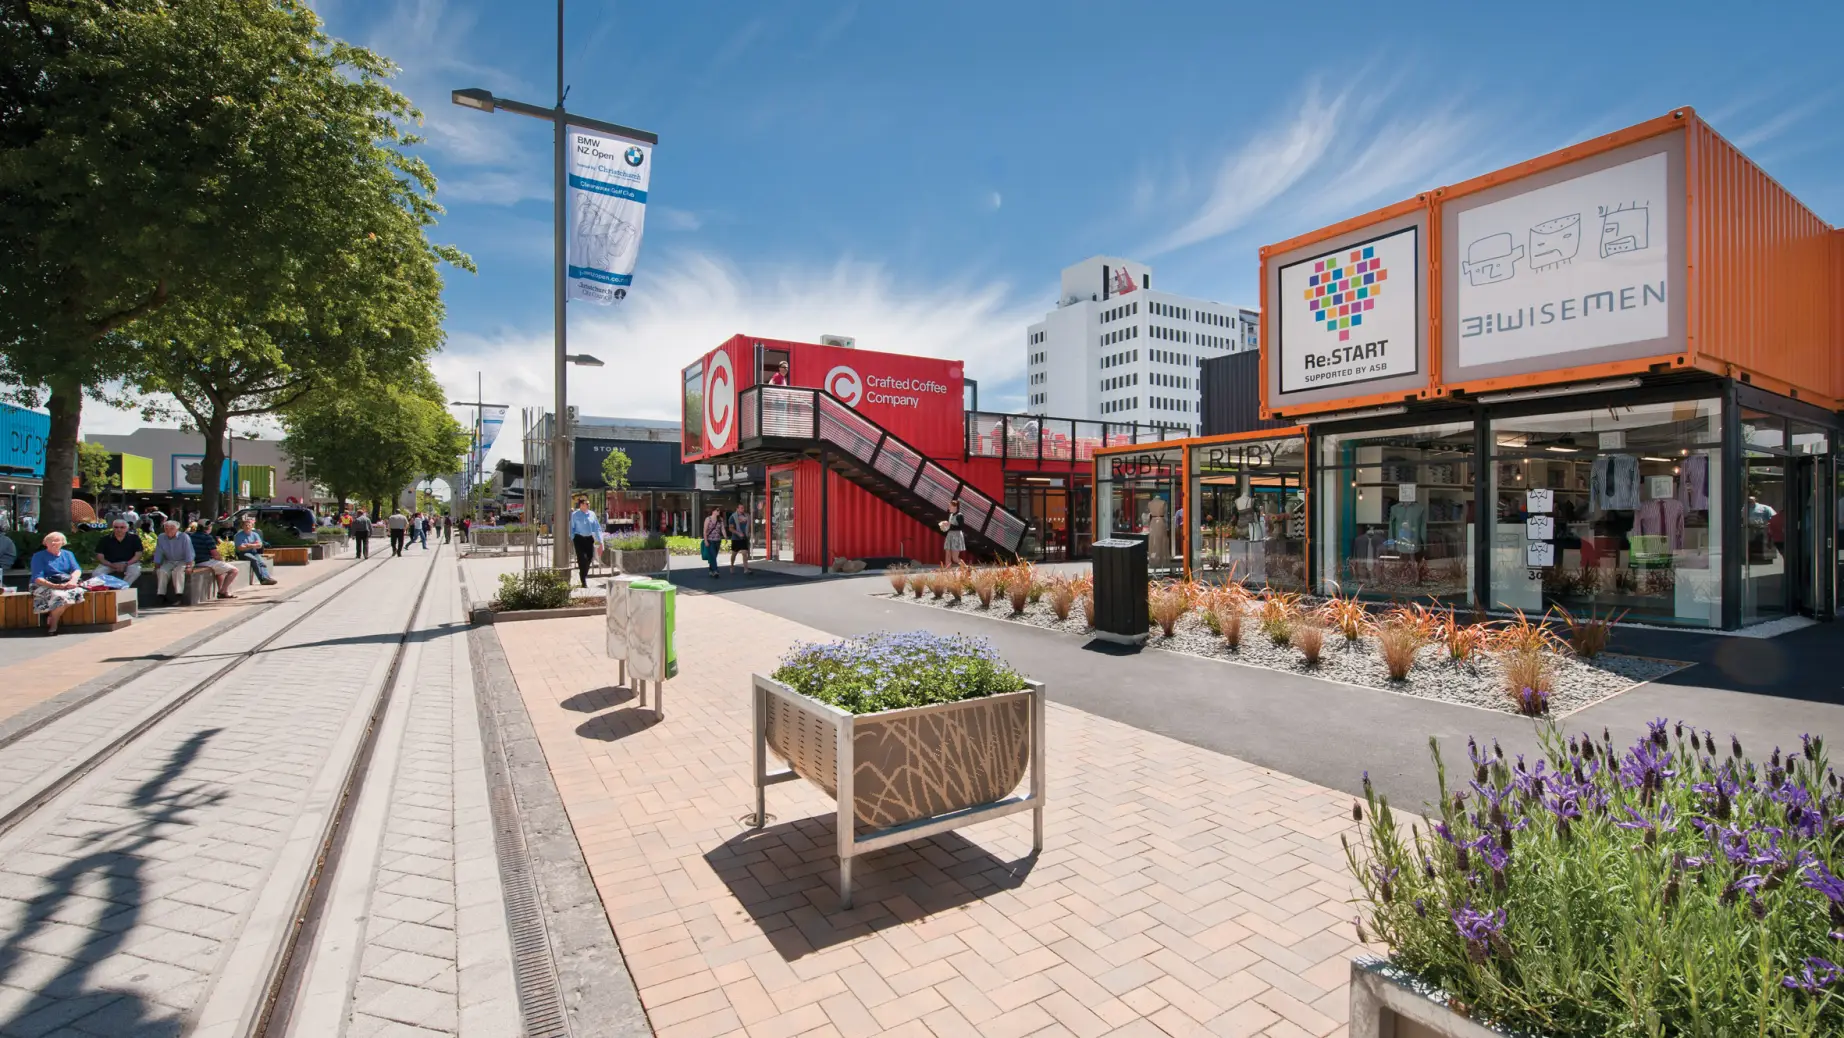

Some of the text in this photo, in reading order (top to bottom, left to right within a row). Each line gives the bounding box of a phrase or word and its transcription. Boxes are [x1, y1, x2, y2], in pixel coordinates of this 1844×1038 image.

[577, 136, 600, 148] BMW
[577, 146, 614, 161] NZ Open
[623, 190, 635, 198] Club
[1305, 340, 1388, 370] Re:START
[1305, 363, 1387, 382] SUPPORTED BY ASB
[866, 375, 947, 394] Crafted Coffee
[866, 391, 919, 408] Company
[1111, 452, 1166, 477] RUBY
[1209, 443, 1282, 471] RUBY
